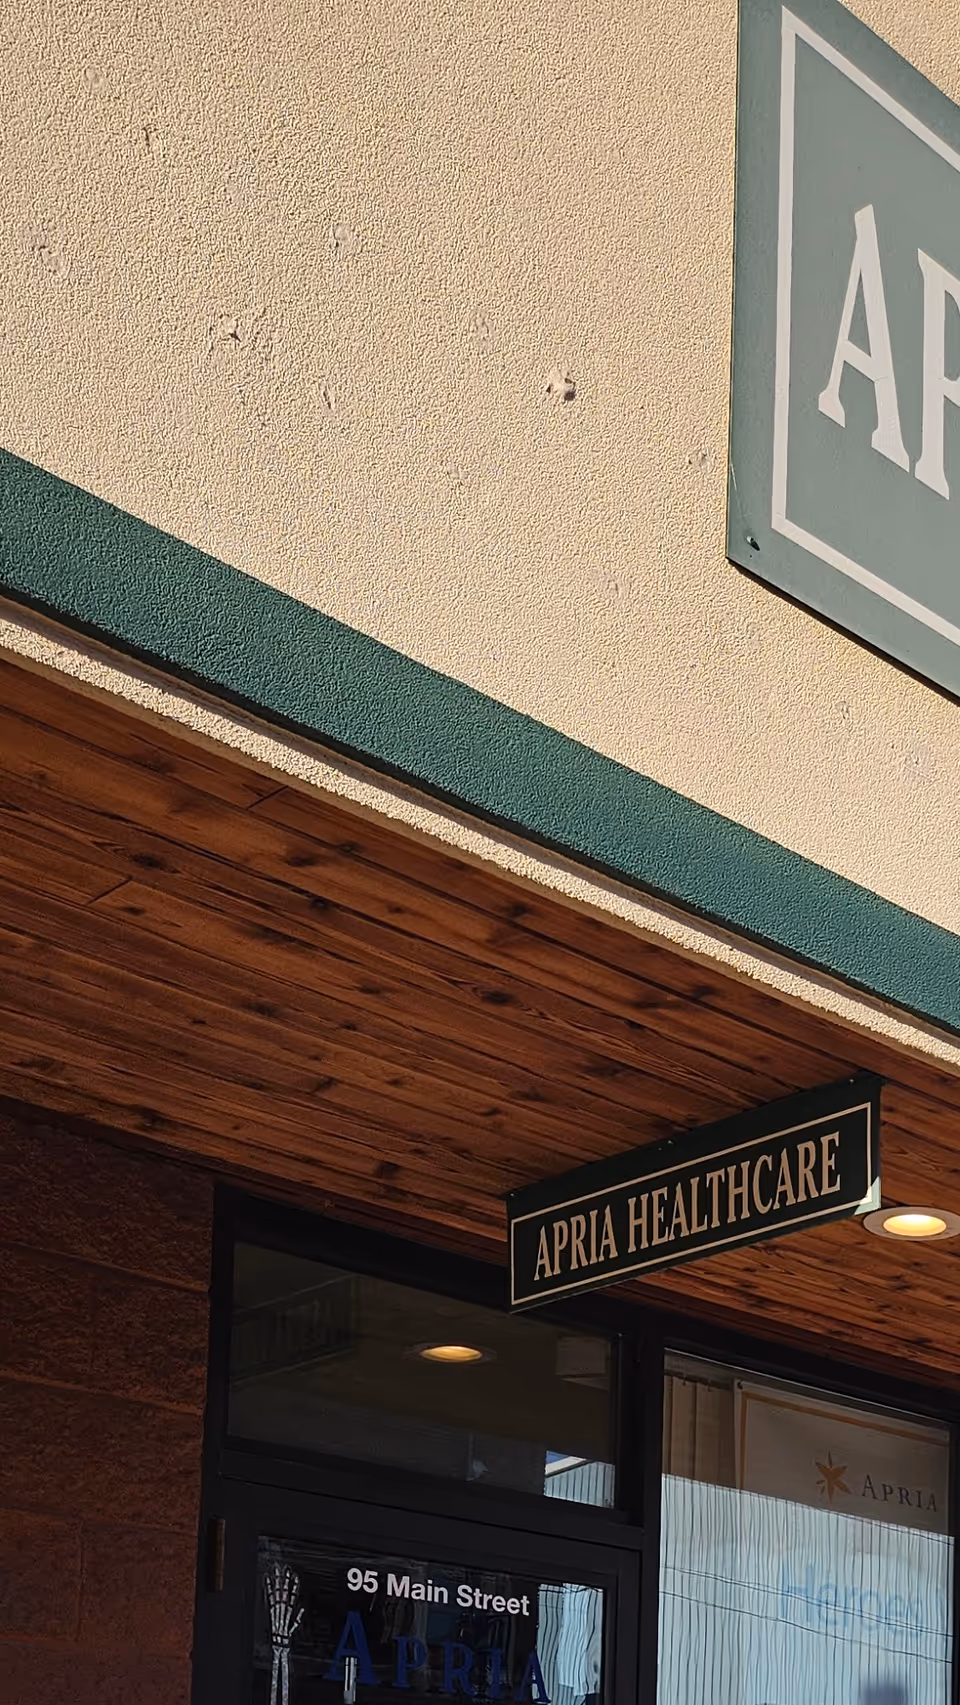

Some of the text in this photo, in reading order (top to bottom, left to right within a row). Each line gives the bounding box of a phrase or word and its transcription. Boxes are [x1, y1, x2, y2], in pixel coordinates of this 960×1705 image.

[534, 1131, 841, 1281] APRIA HEALTHCARE
[862, 1474, 938, 1512] APRIA
[347, 1568, 530, 1616] 95 Main Street
[323, 1611, 551, 1704] APRIA
